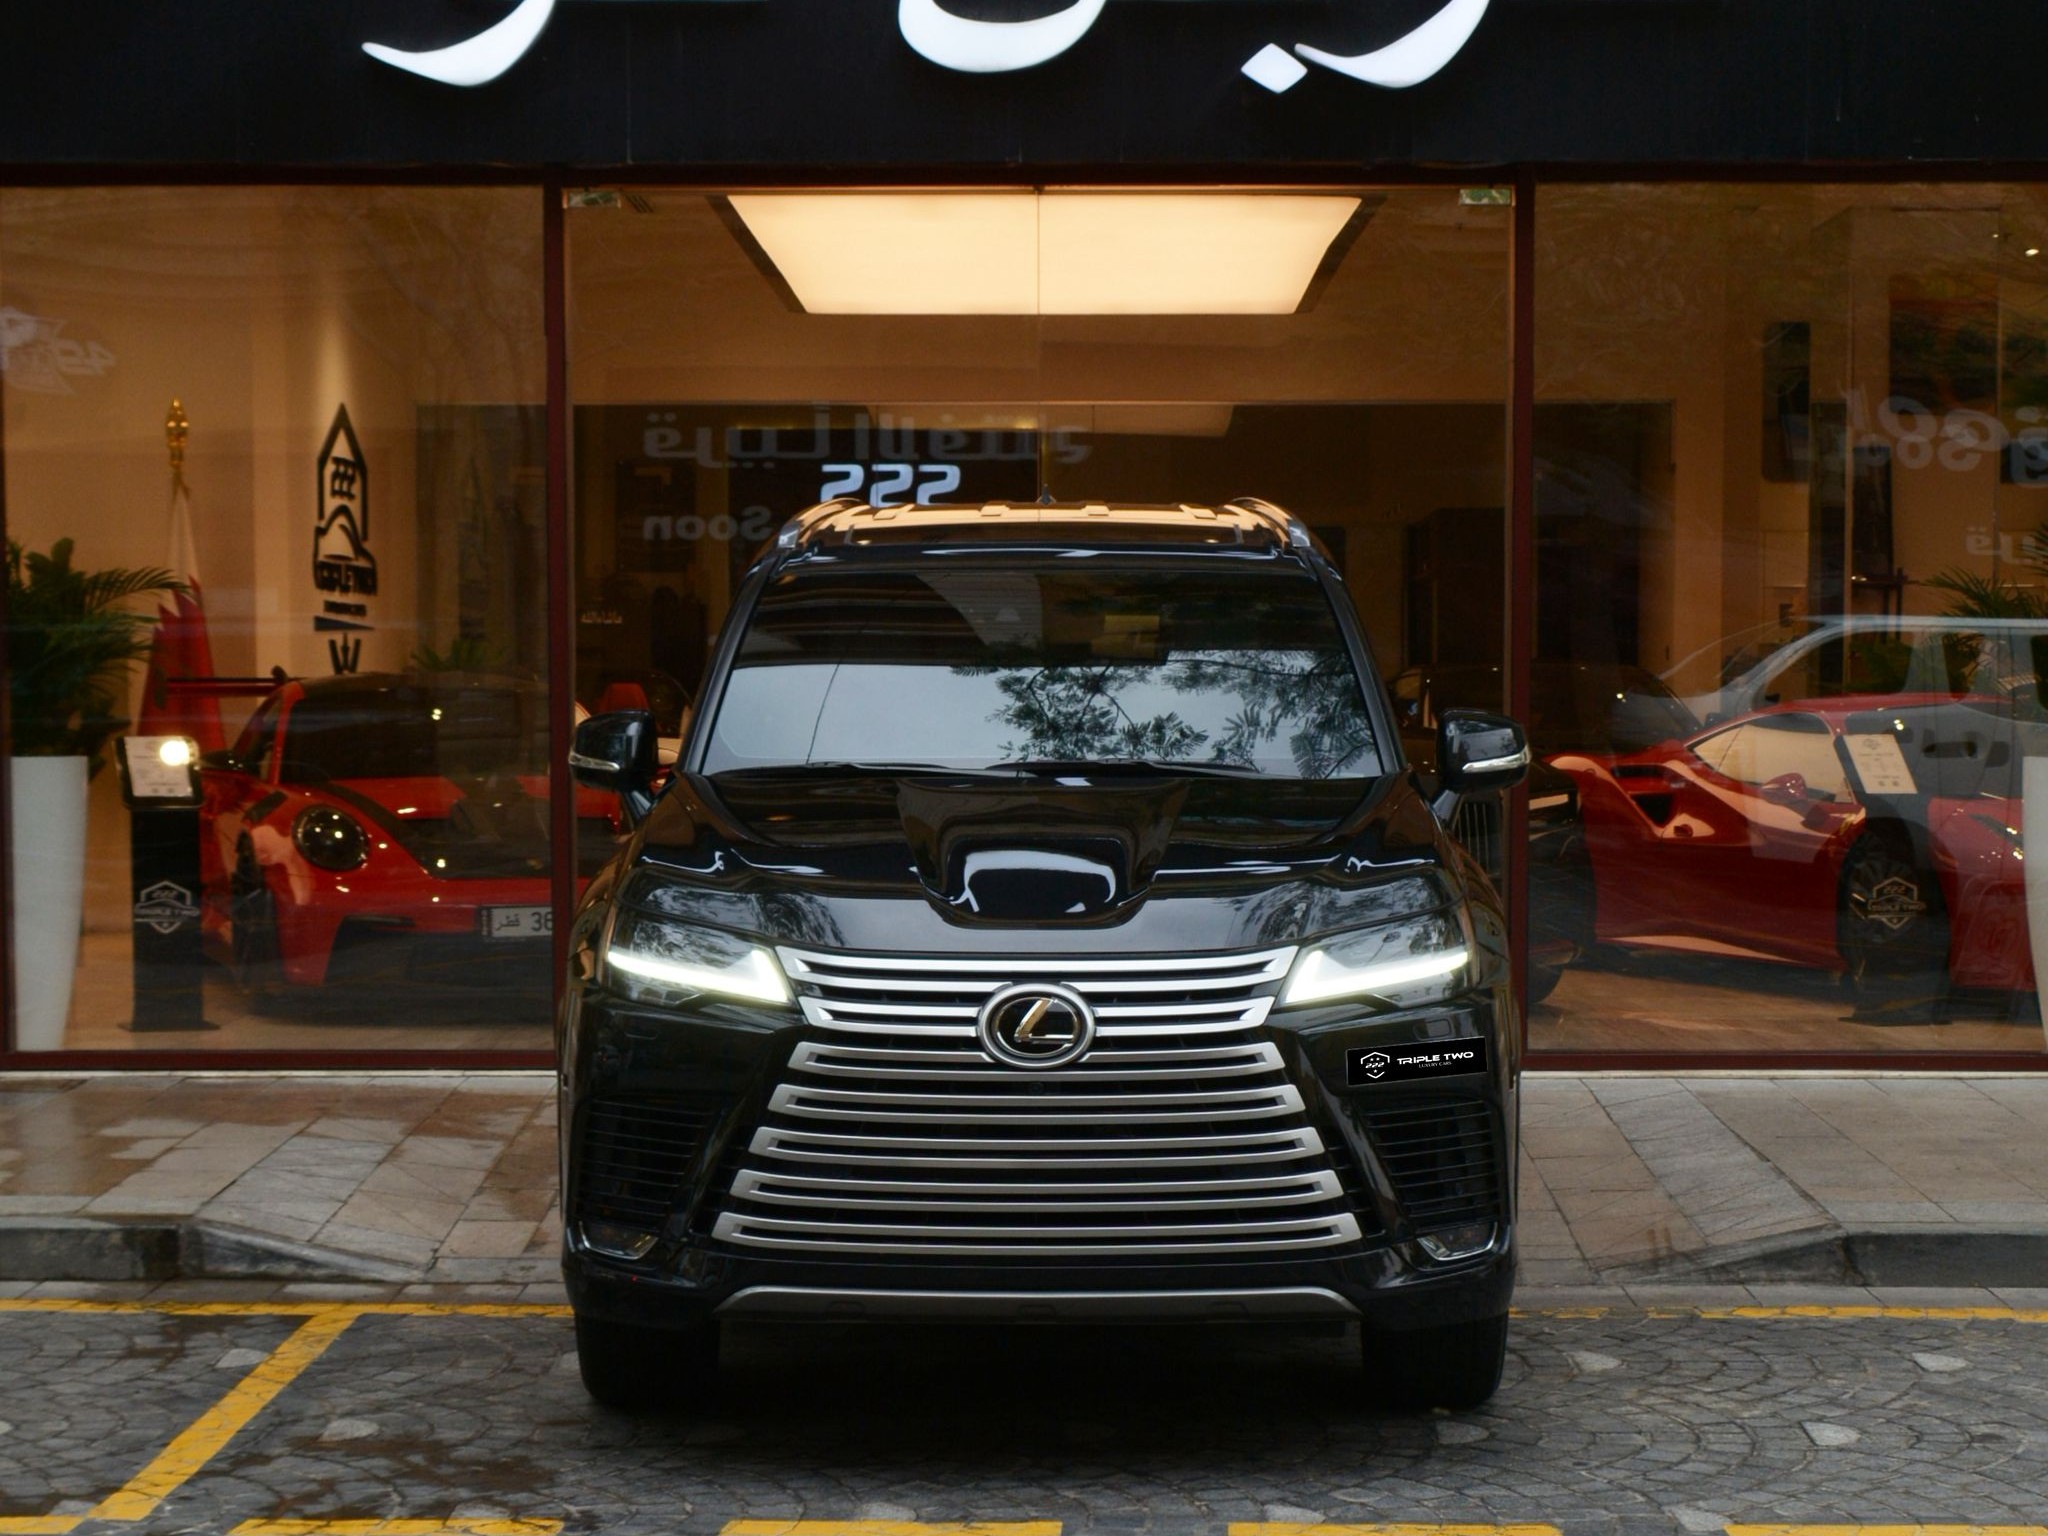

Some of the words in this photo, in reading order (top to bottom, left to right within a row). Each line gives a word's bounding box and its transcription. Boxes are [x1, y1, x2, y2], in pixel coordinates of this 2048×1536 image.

[819, 463, 961, 509] 222
[1365, 1061, 1385, 1069] 222
[1397, 1054, 1440, 1065] TRIPLE
[1443, 1051, 1474, 1061] TWO
